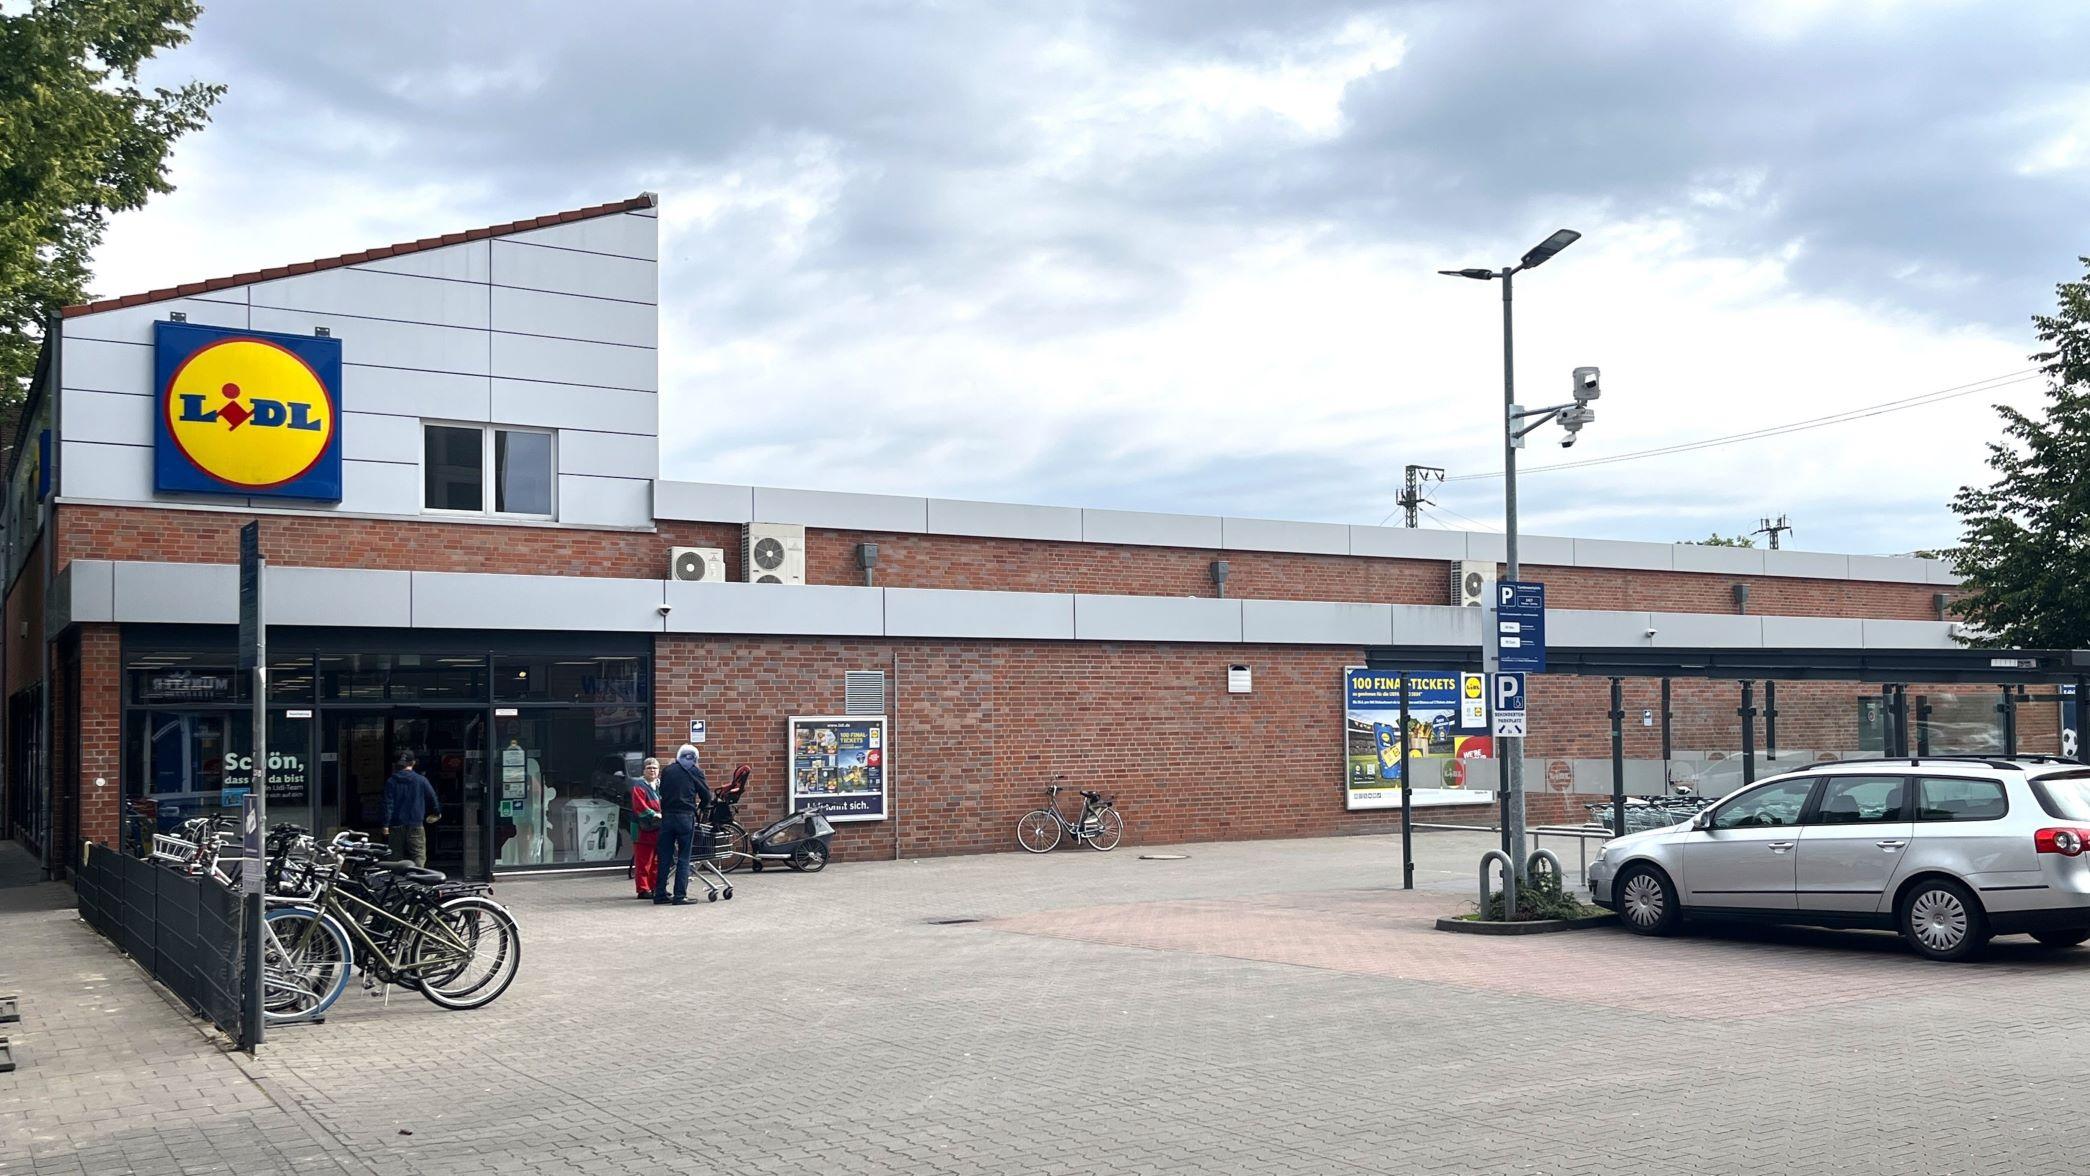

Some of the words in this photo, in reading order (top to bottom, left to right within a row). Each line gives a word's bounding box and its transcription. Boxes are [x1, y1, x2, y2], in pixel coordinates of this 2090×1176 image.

[1501, 587, 1513, 604] P
[1352, 677, 1368, 689] 100
[1374, 677, 1456, 690] FINA-TICKETS
[1498, 676, 1518, 709] P
[225, 752, 304, 772] Scön,
[224, 776, 249, 784] dass
[268, 775, 282, 783] da
[284, 774, 304, 783] bist
[849, 800, 870, 810] sich.
